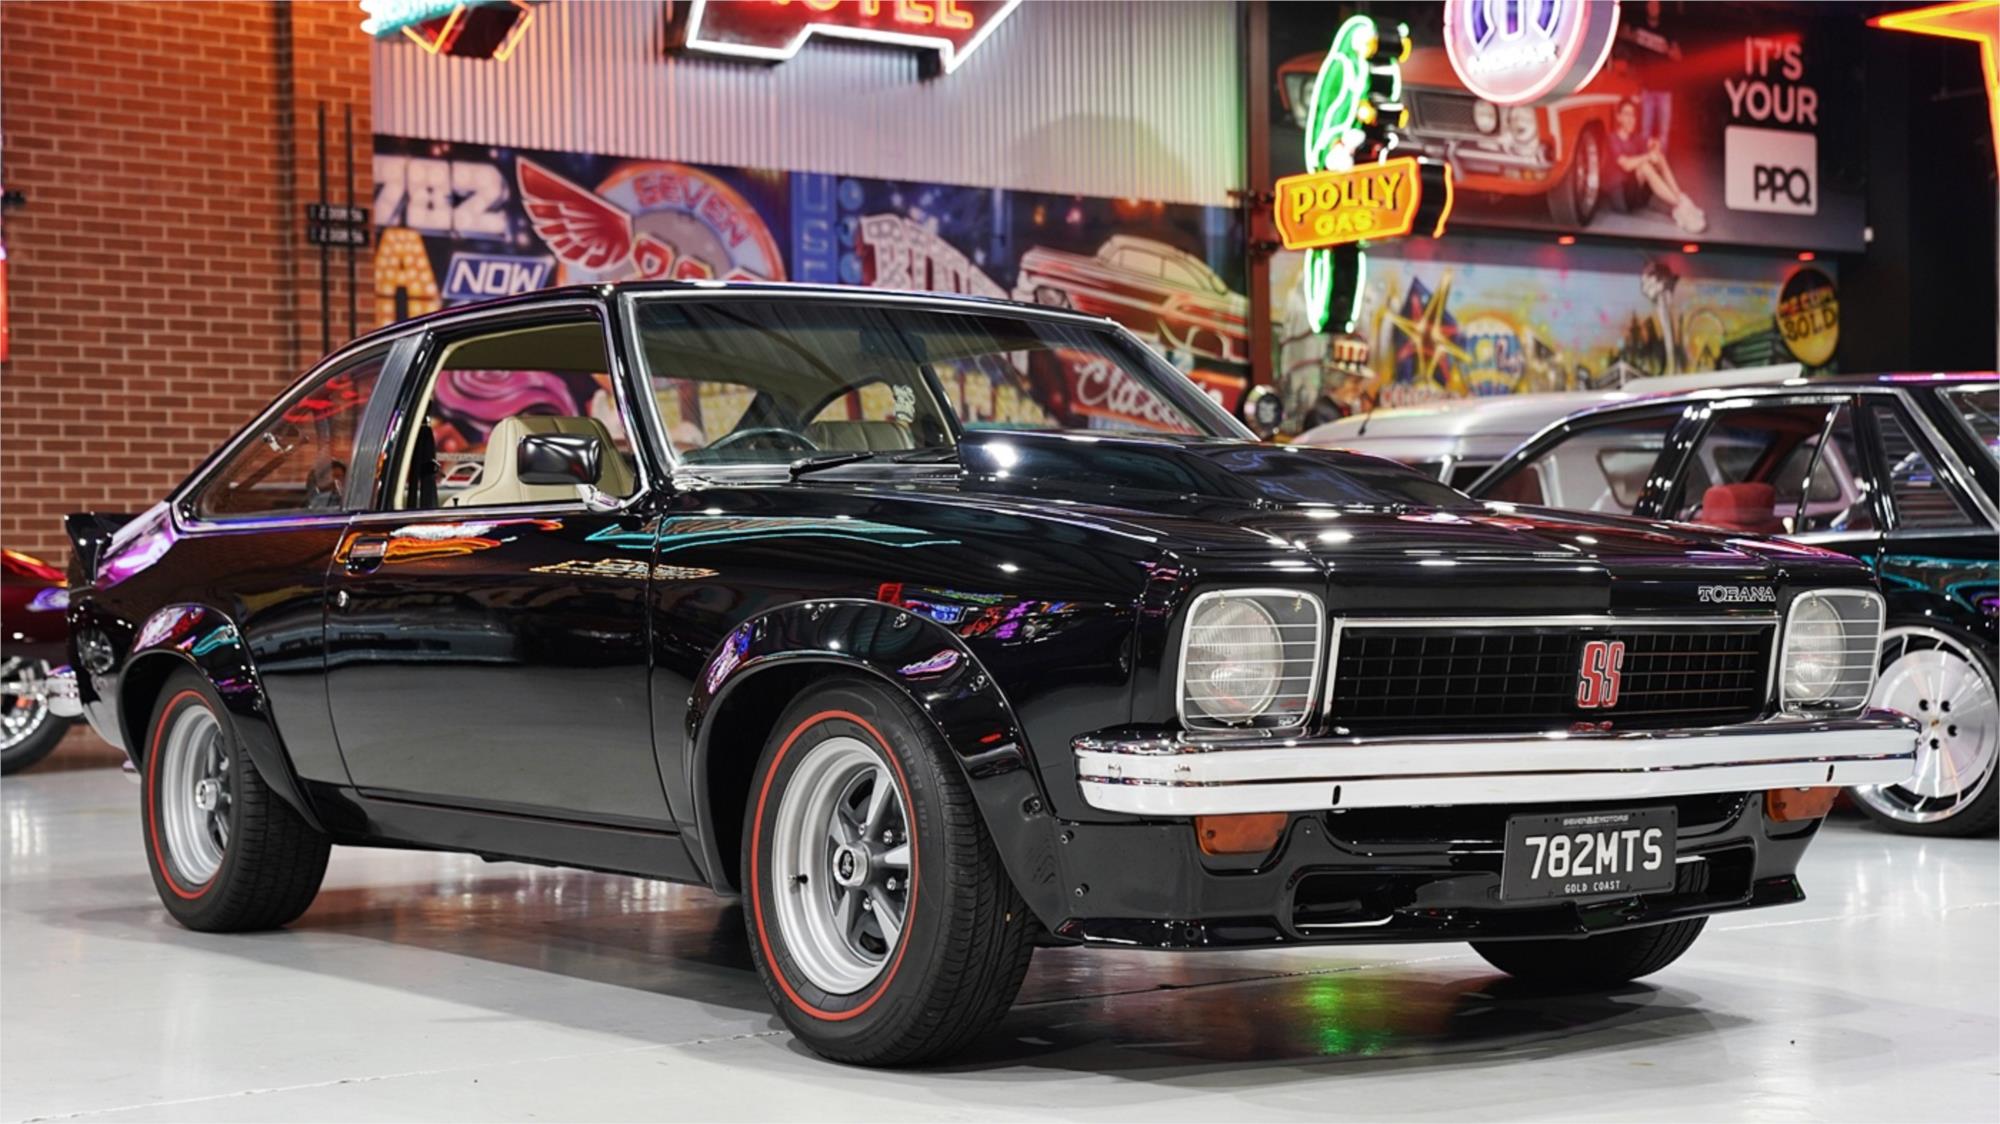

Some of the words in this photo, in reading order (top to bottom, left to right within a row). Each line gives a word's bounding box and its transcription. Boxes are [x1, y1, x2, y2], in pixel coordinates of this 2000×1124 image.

[1745, 36, 1803, 81] IT'S
[1724, 78, 1818, 126] YOUR
[374, 155, 511, 238] 782
[1290, 172, 1402, 223] POLLY
[1754, 164, 1812, 207] PPQ
[633, 174, 751, 248] SEVEN
[1314, 208, 1374, 236] GAS
[451, 261, 543, 297] NOW
[1697, 585, 1777, 603] TORANA
[1578, 641, 1625, 708] SS
[1525, 828, 1663, 880] 782MTS
[1564, 882, 1588, 894] GOLD
[1593, 880, 1621, 892] COAST
